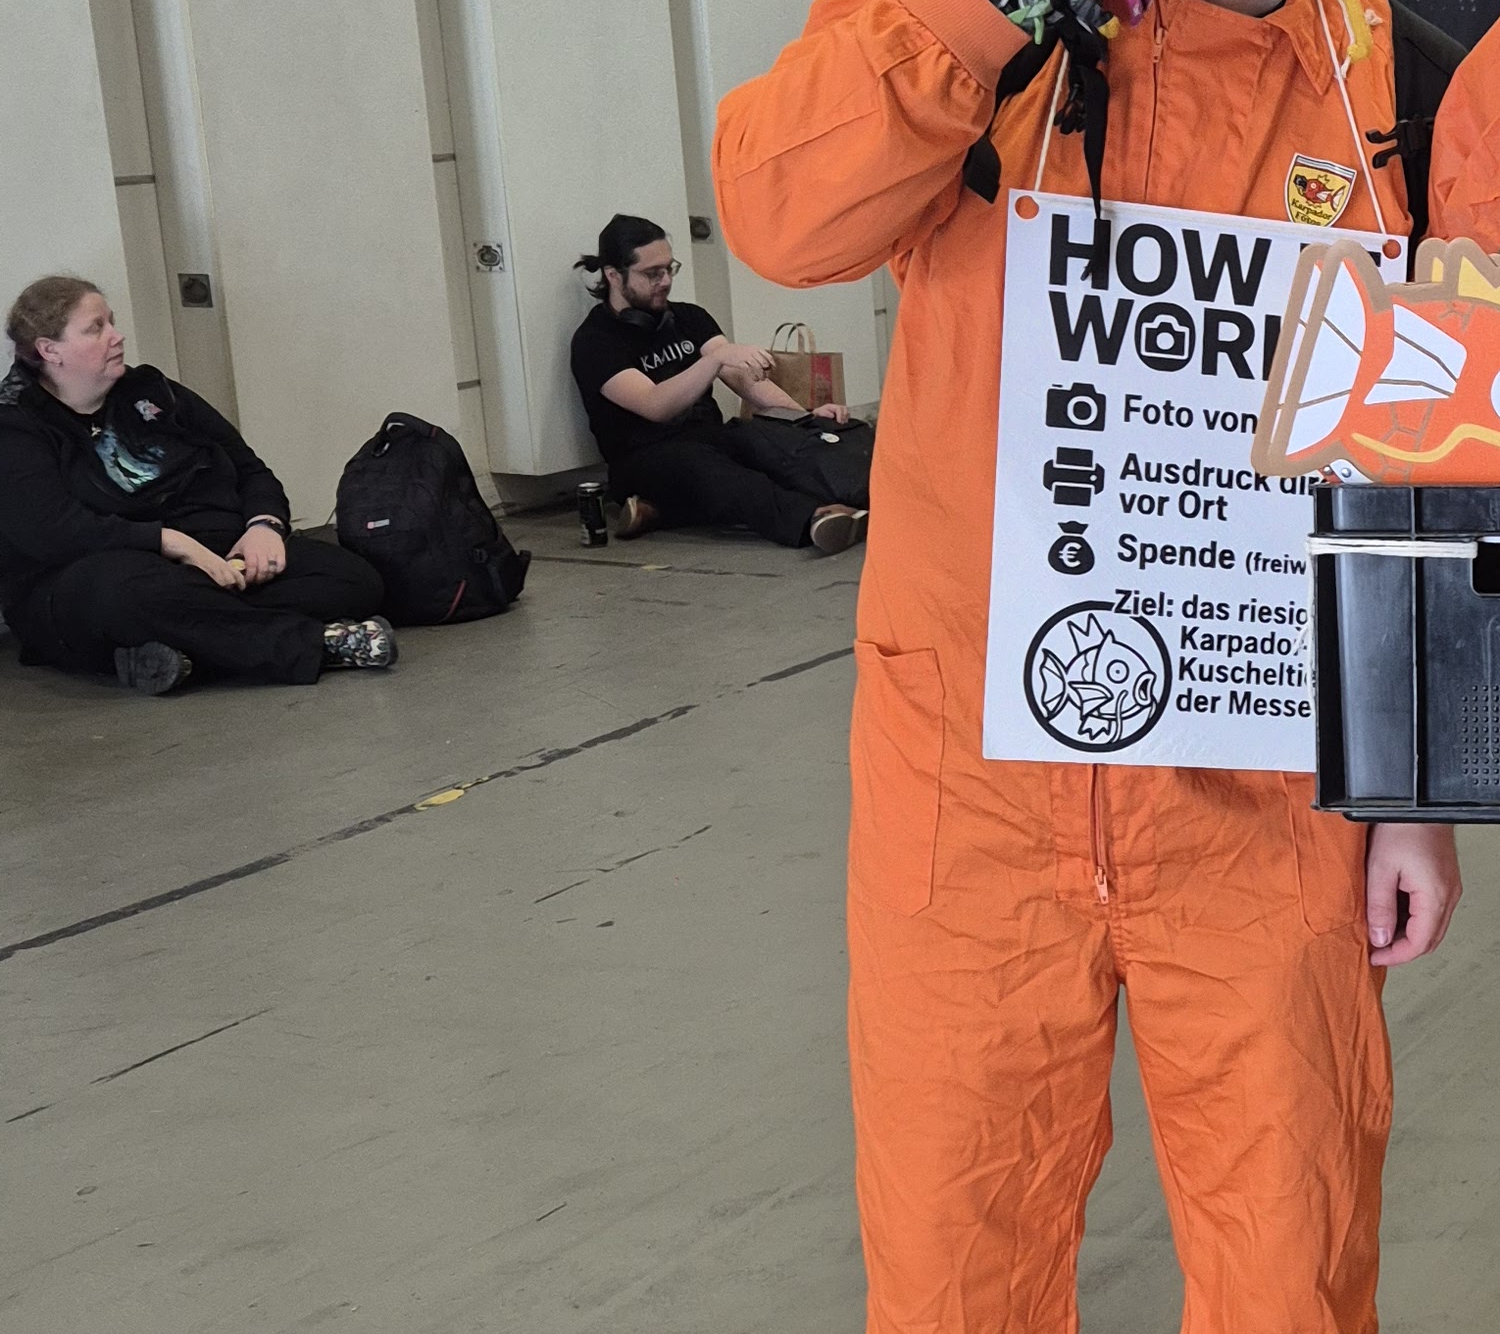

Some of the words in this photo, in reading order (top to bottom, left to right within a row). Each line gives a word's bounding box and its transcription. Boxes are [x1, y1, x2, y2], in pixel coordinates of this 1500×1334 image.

[1291, 198, 1332, 220] Karpador
[1049, 213, 1272, 307] HOW
[1123, 393, 1194, 428] Foto
[1203, 409, 1258, 434] von
[1119, 452, 1271, 492] Ausdruck
[1119, 492, 1170, 516] vor
[1178, 490, 1228, 521] Ort
[1117, 533, 1236, 570] Spende
[1114, 589, 1174, 617] Ziel:
[1181, 594, 1230, 621] das
[1178, 656, 1308, 687] Kuschelti
[1176, 688, 1221, 713] der
[1228, 690, 1312, 718] Messe
